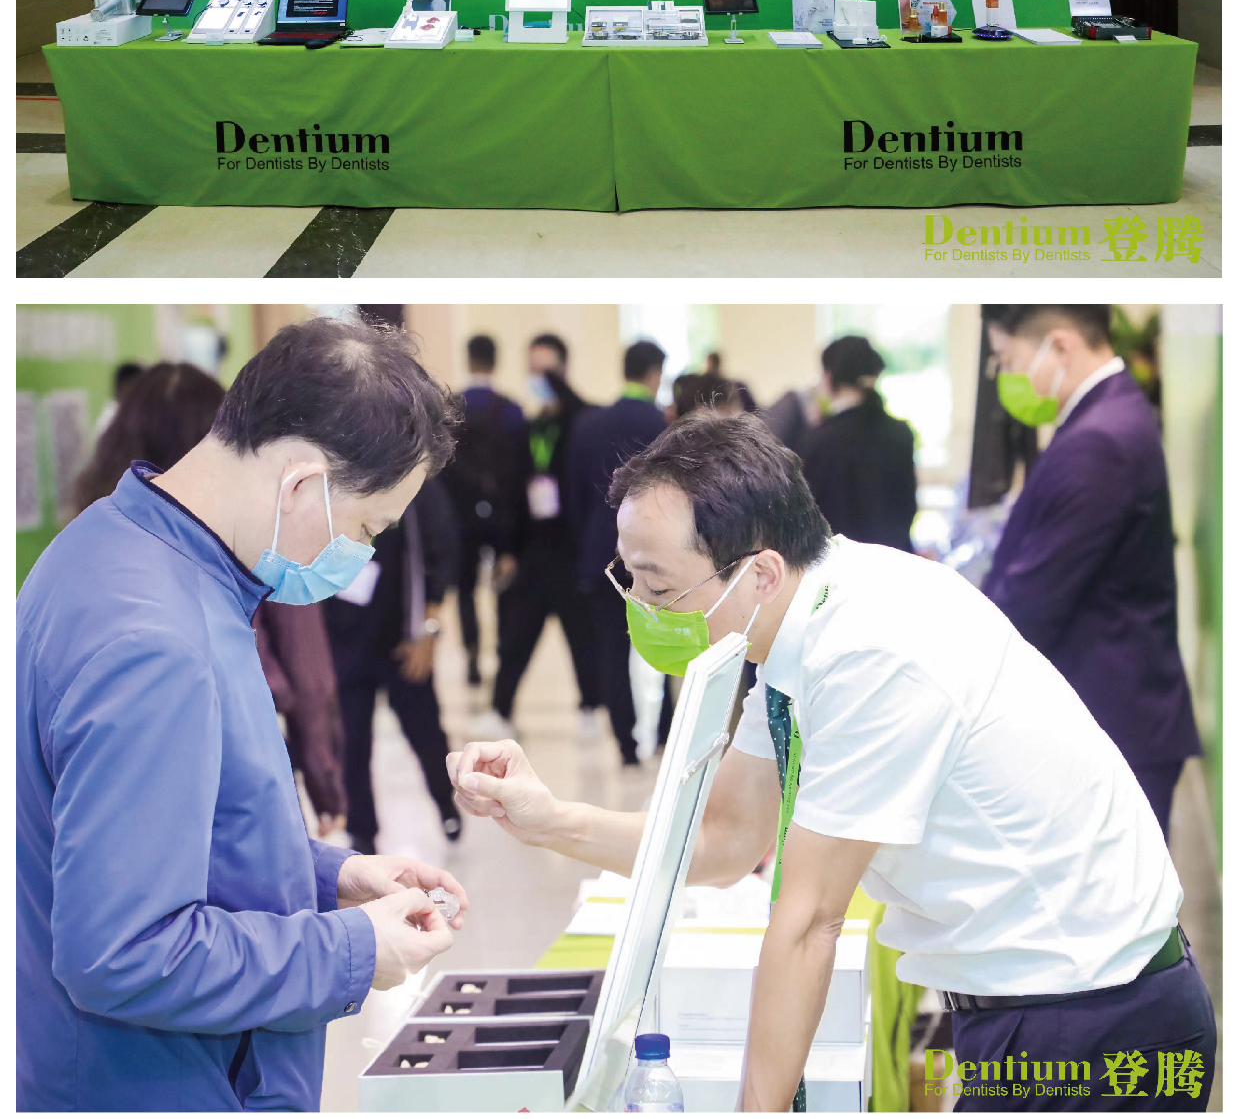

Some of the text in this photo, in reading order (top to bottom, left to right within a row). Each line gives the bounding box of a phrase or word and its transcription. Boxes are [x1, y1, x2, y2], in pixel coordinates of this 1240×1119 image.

[215, 120, 390, 154] Dentium
[843, 120, 1023, 154] Dentium
[217, 157, 390, 173] For Dentists By Dentists
[844, 154, 1022, 172] For Dentists By Dentists
